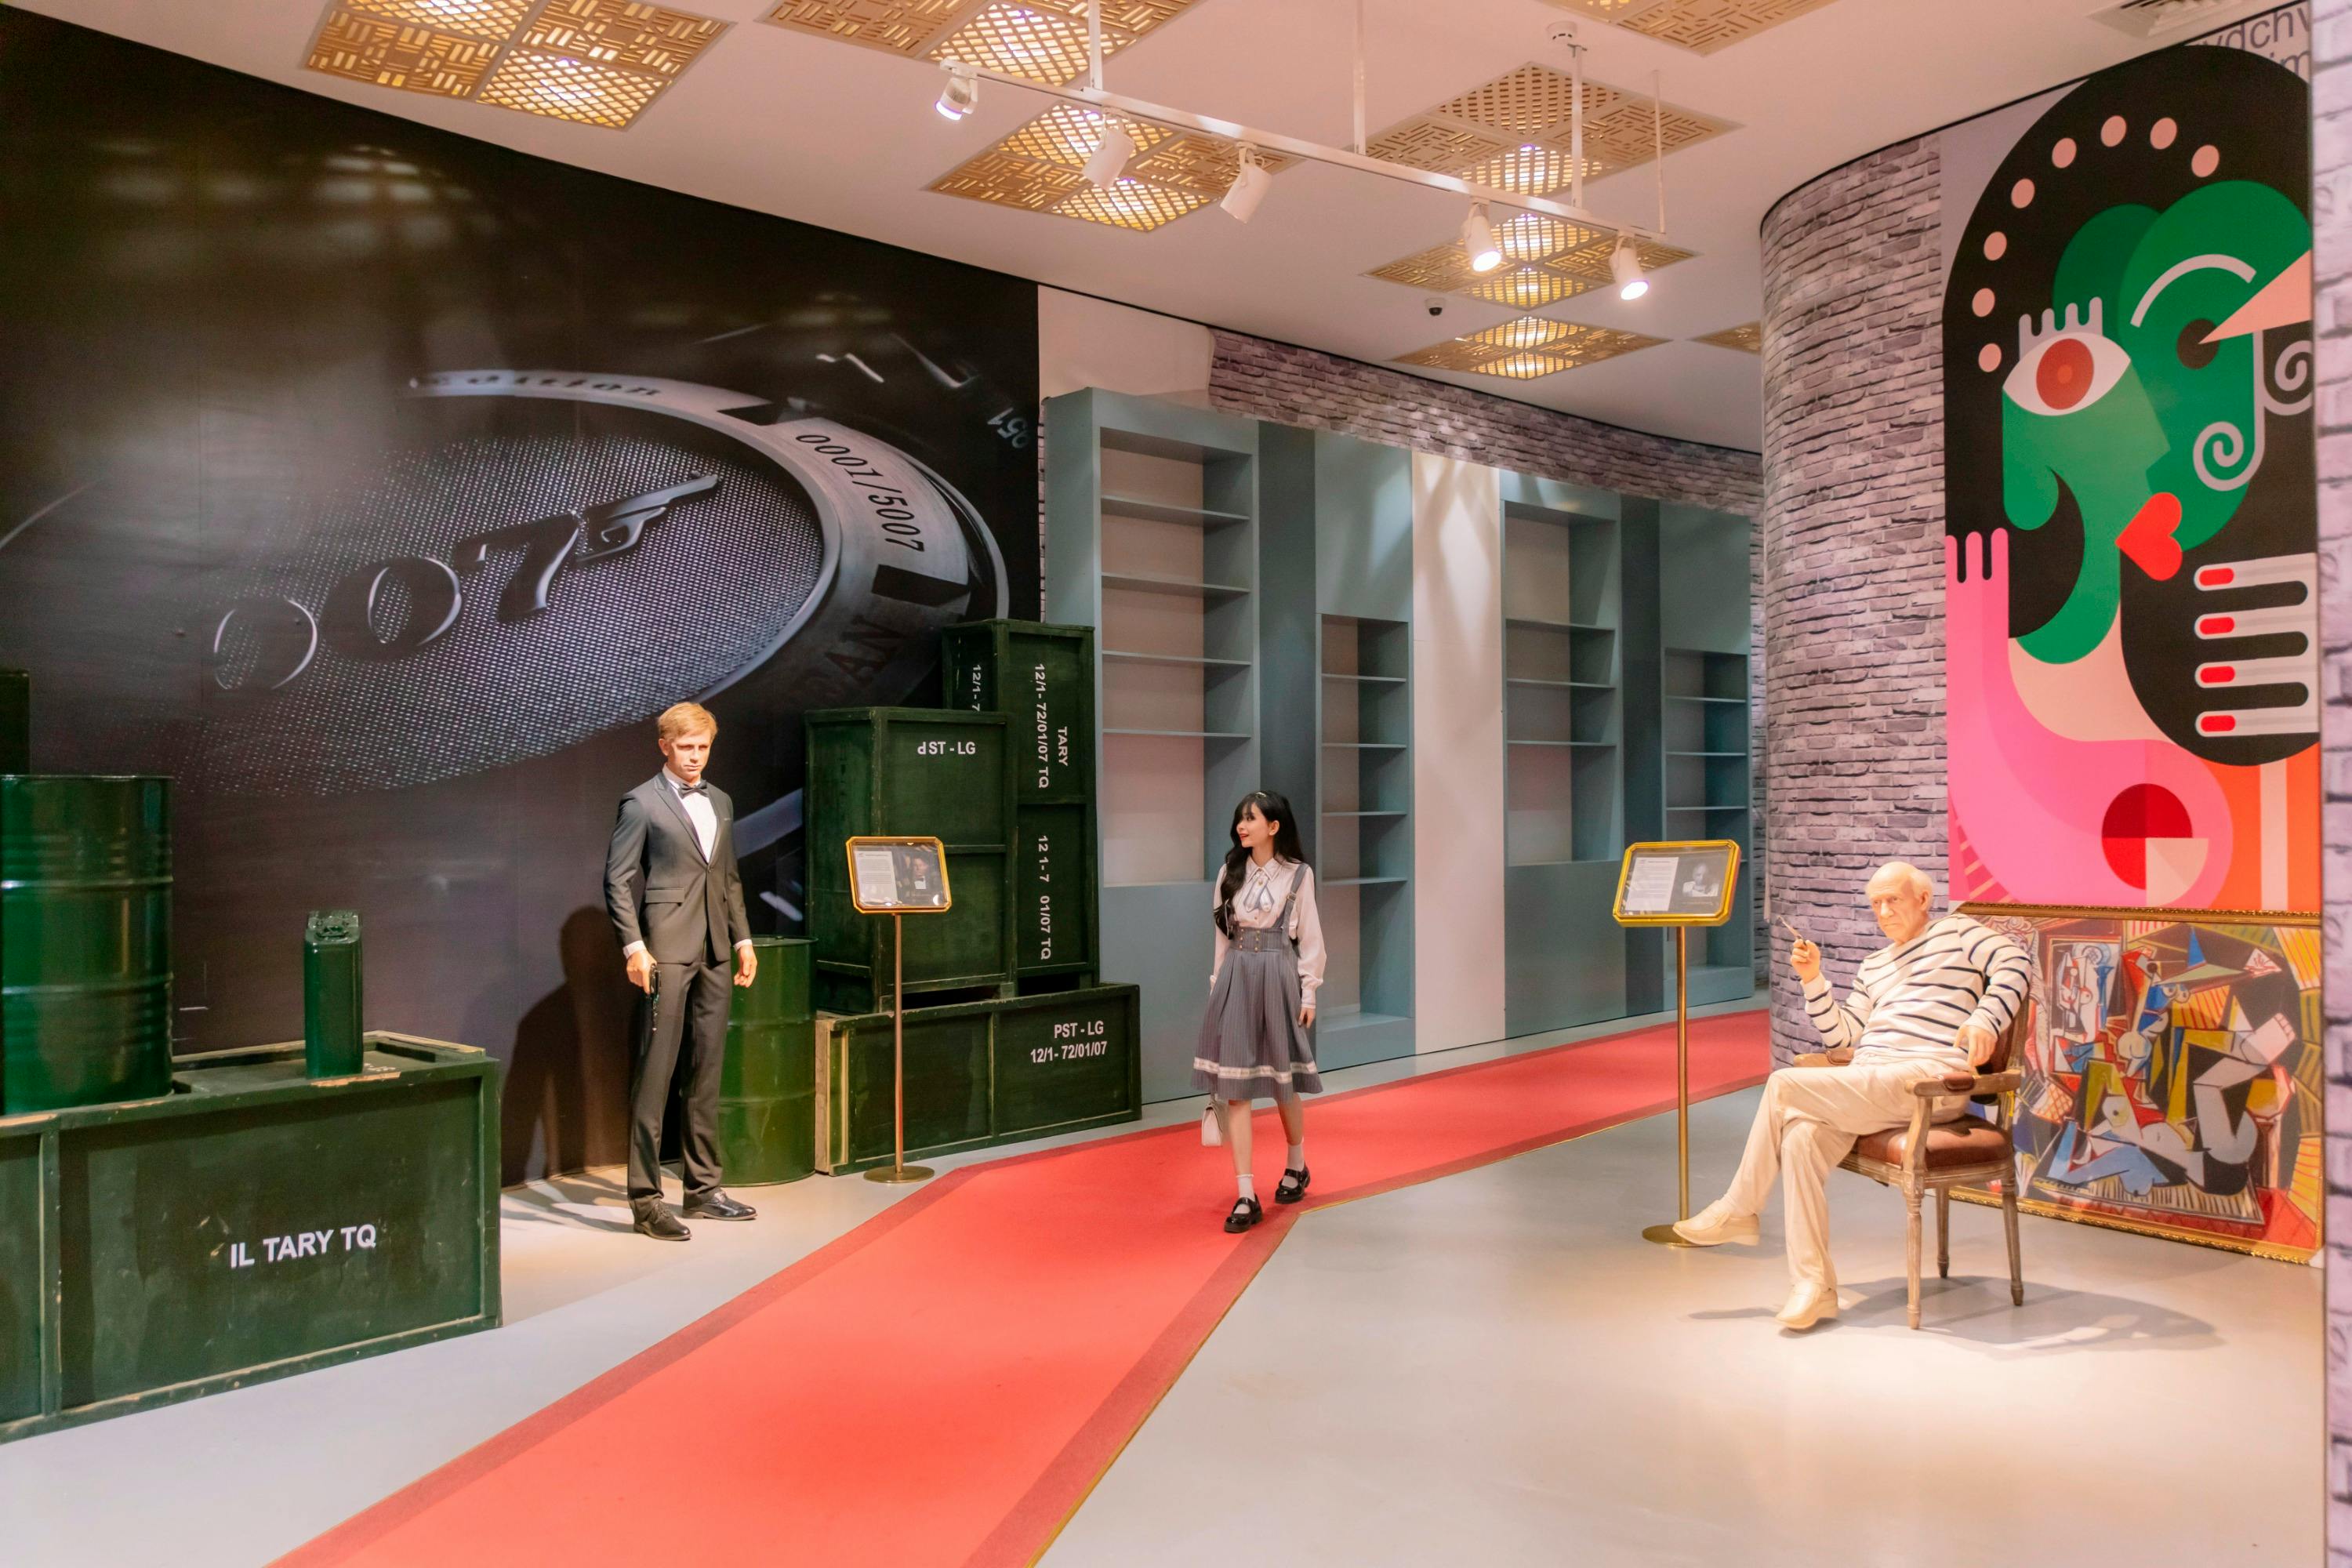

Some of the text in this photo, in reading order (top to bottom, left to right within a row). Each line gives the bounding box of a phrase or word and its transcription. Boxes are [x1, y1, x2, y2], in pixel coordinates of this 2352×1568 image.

[796, 434, 925, 552] 0001/5007
[196, 506, 584, 696] 007
[957, 741, 976, 754] LG
[1036, 702, 1048, 762] 72/01/07
[1058, 726, 1069, 767] TARY
[1038, 766, 1050, 789] TQ
[1040, 895, 1051, 934] 01/07
[1040, 938, 1051, 960] TQ
[1054, 1022, 1078, 1039] PST
[1087, 1020, 1104, 1036] LG
[1061, 1040, 1108, 1059] 72/01/07
[230, 1223, 377, 1269] IL TARY TQ
